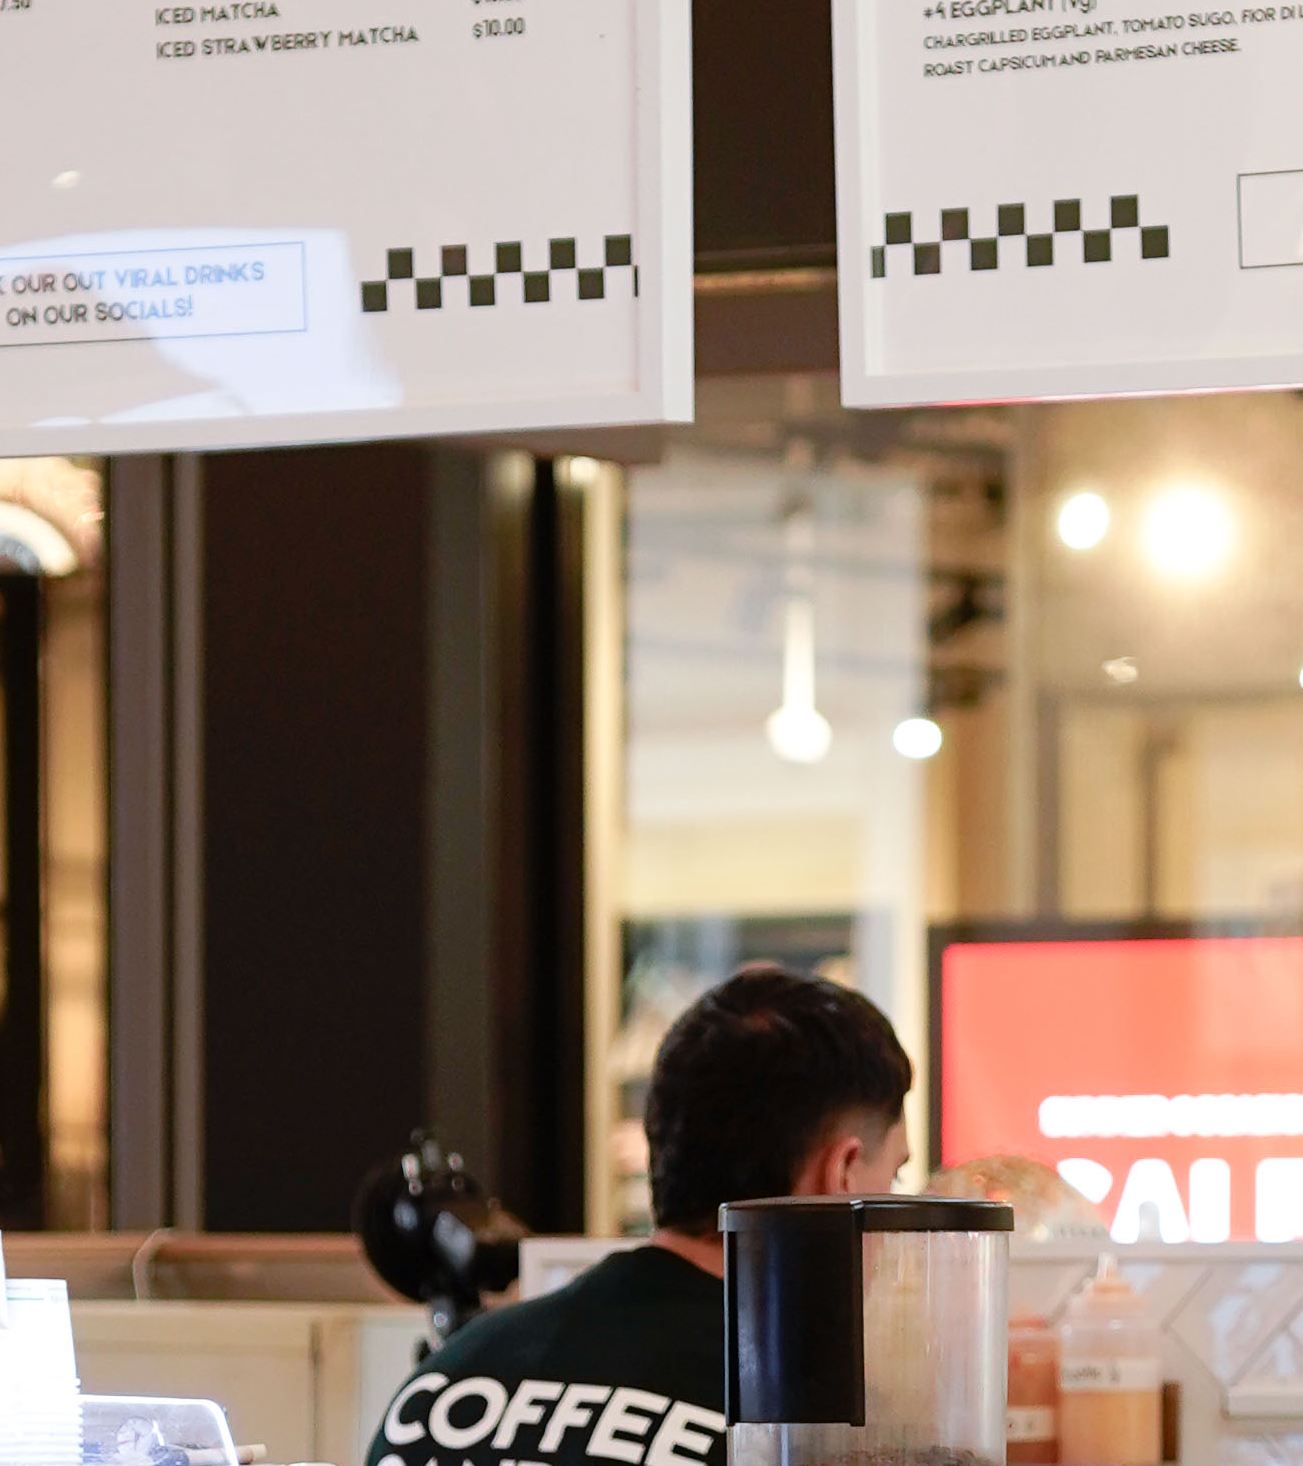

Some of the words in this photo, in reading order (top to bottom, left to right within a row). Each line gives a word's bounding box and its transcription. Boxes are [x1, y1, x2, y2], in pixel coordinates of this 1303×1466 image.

[154, 5, 195, 25] ICED
[199, 0, 280, 22] MATCHA
[155, 39, 196, 59] ICED
[201, 30, 332, 56] STRAWBERRY
[337, 25, 419, 47] MATCHA
[9, 271, 58, 296] OUR
[60, 269, 106, 294] OUT
[114, 267, 178, 288] VIRAL
[183, 260, 265, 286] DRINKS
[4, 305, 39, 328] ON
[41, 301, 89, 327] OUR
[93, 295, 193, 323] SOCIALS!
